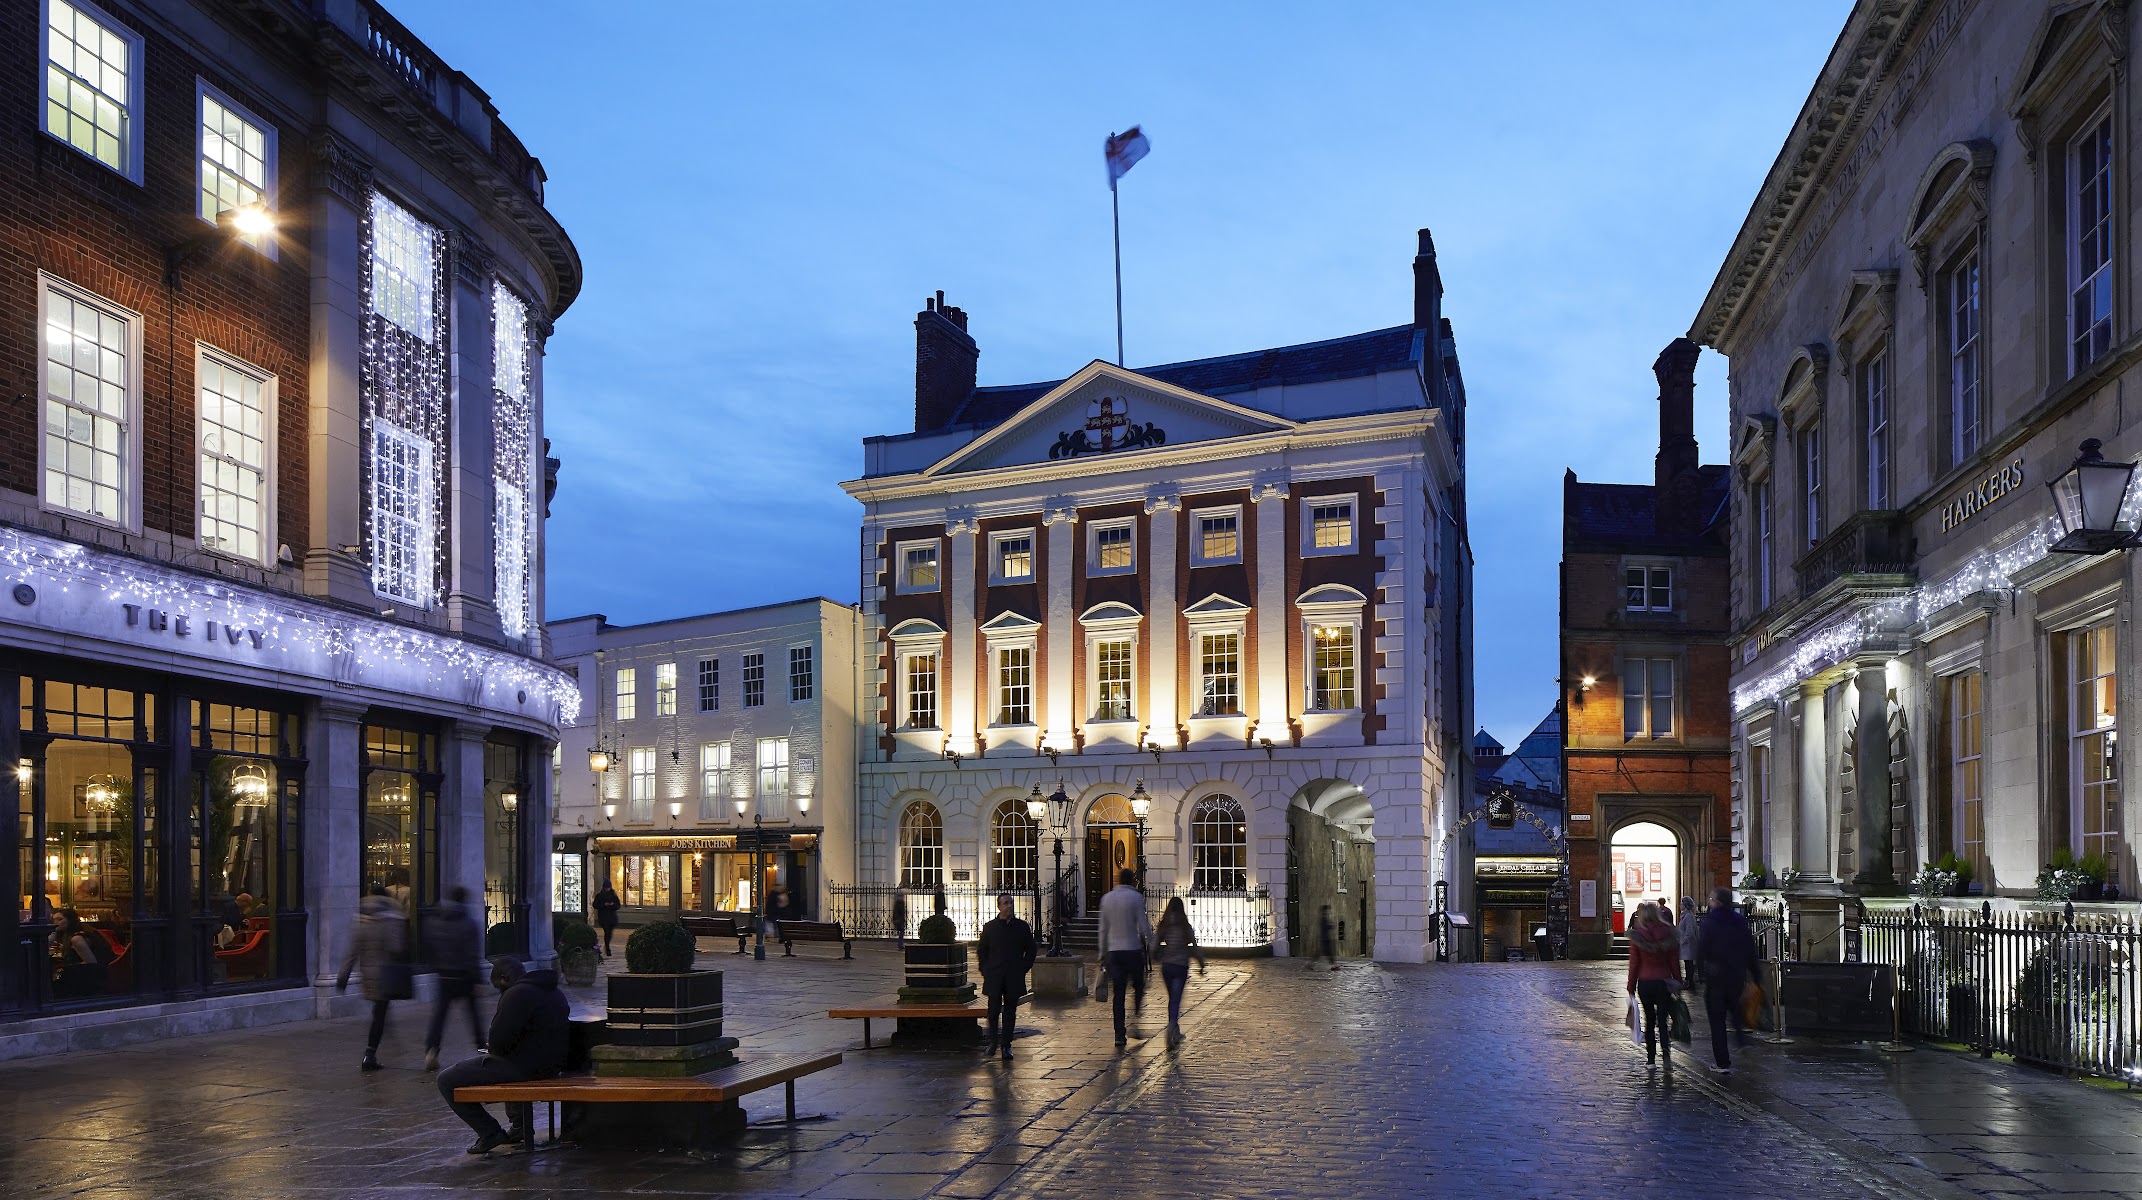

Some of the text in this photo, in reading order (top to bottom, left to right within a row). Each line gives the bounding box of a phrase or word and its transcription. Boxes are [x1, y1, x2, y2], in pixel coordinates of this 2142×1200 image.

[1941, 459, 2024, 534] HARKERS
[122, 603, 267, 650] THE IVY
[1757, 630, 1776, 652] HAR
[671, 838, 694, 849] JOE'S
[694, 838, 732, 849] KITCHEN
